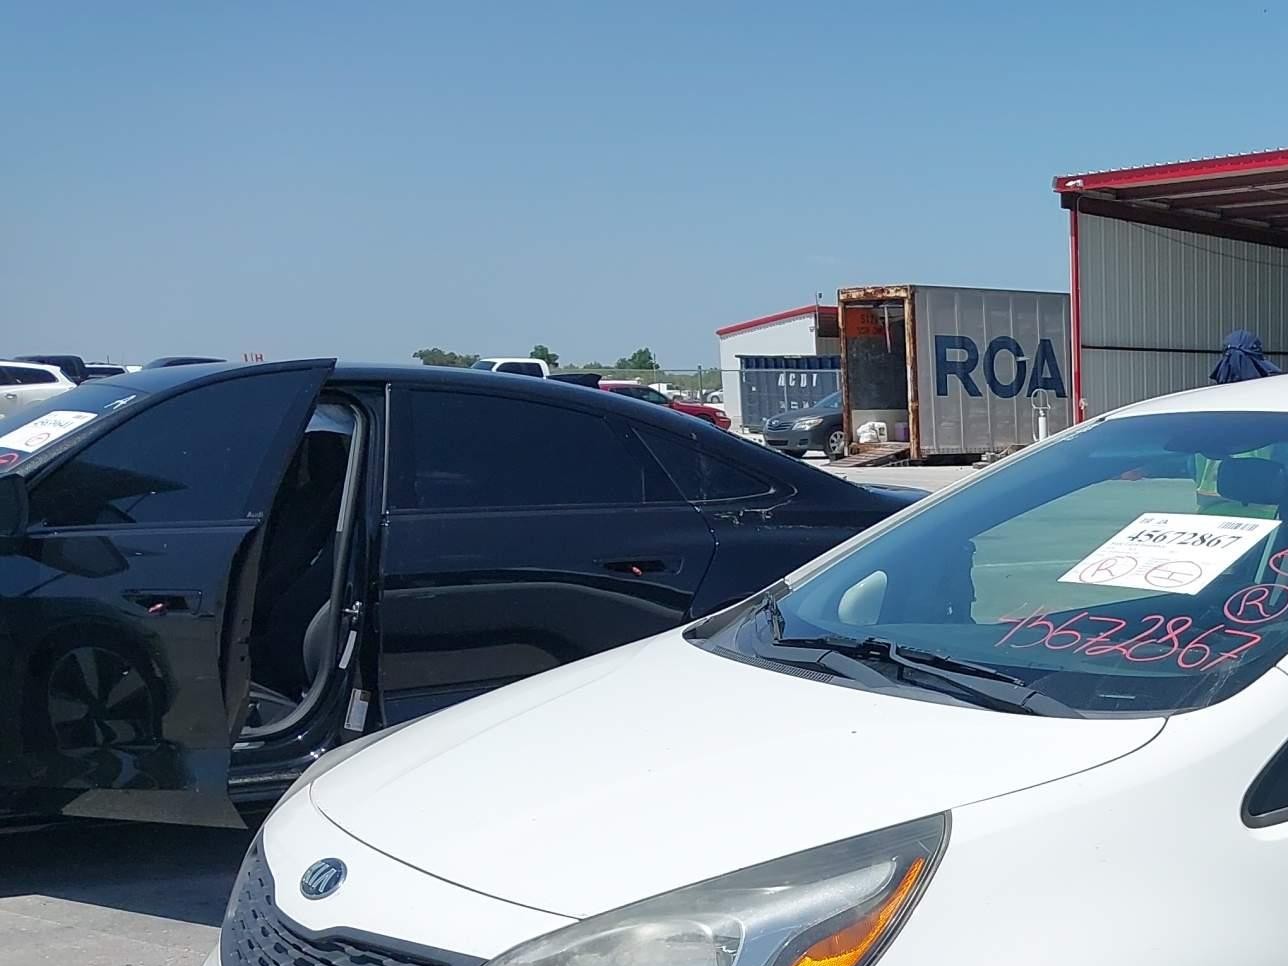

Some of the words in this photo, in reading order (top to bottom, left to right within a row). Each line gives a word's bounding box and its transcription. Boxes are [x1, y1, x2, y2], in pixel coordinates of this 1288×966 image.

[935, 335, 1067, 398] ROA
[1128, 529, 1243, 549] 45672867
[1237, 587, 1270, 617] R
